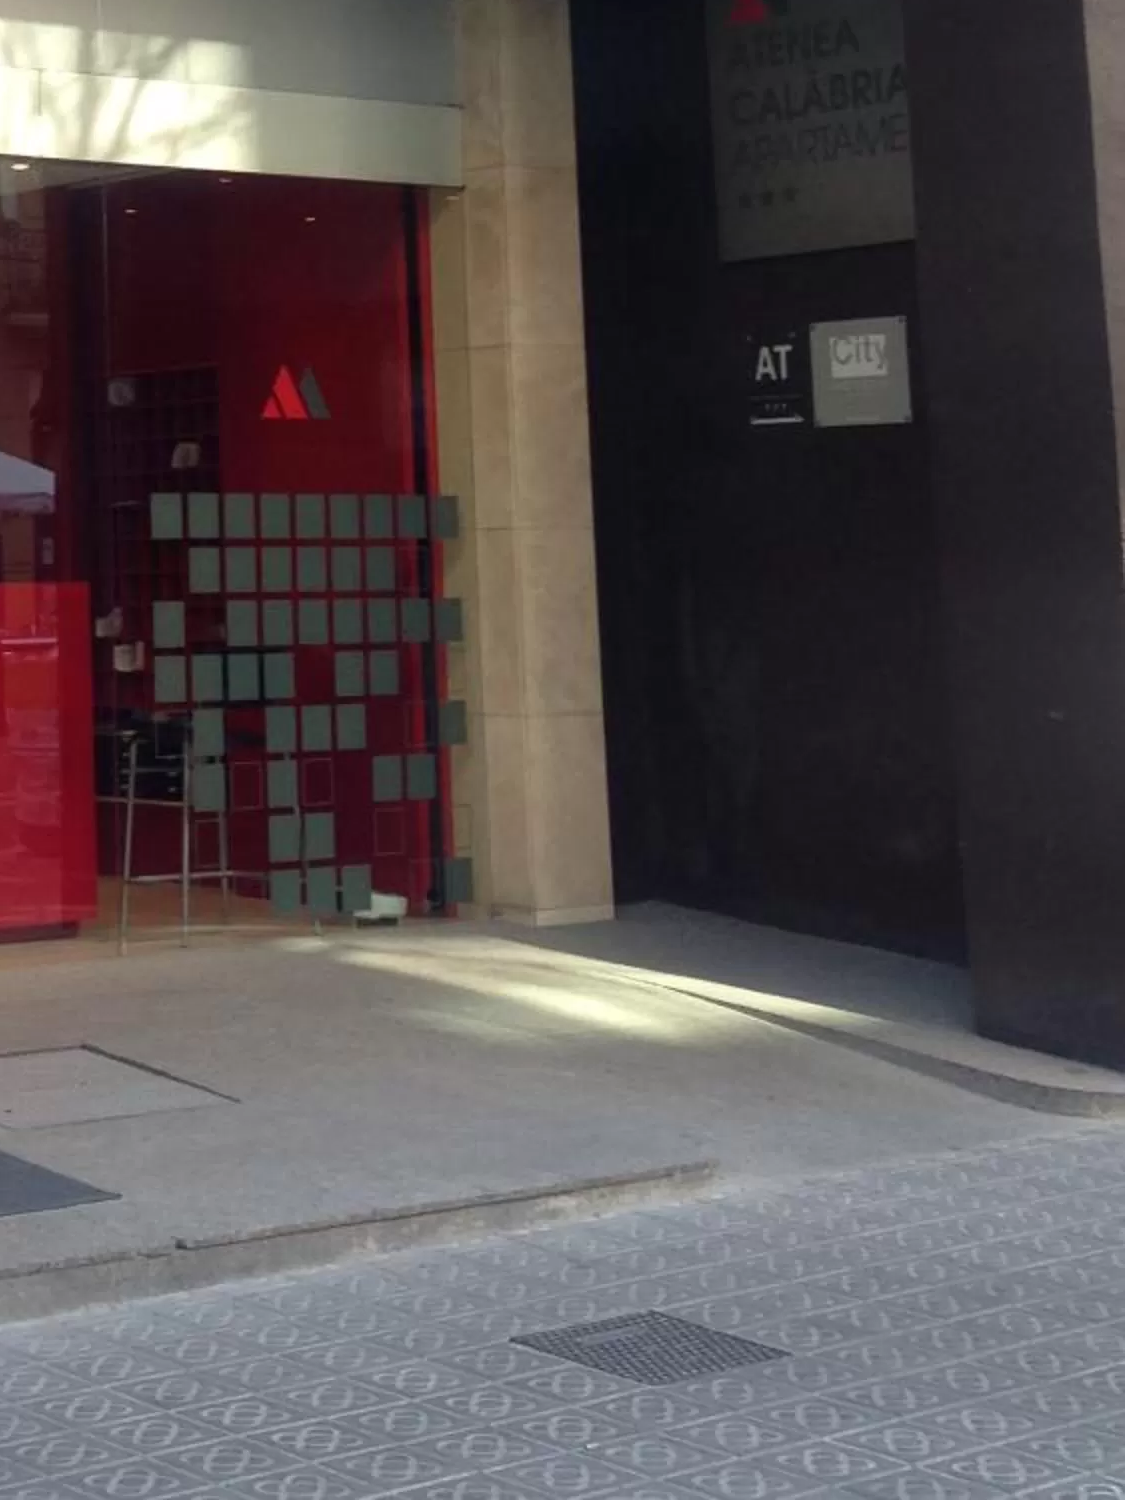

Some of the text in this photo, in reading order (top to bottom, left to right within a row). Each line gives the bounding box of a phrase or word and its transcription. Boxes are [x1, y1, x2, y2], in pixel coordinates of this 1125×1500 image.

[726, 17, 860, 71] ATENEA
[755, 343, 794, 382] AT
[832, 337, 886, 370] City
